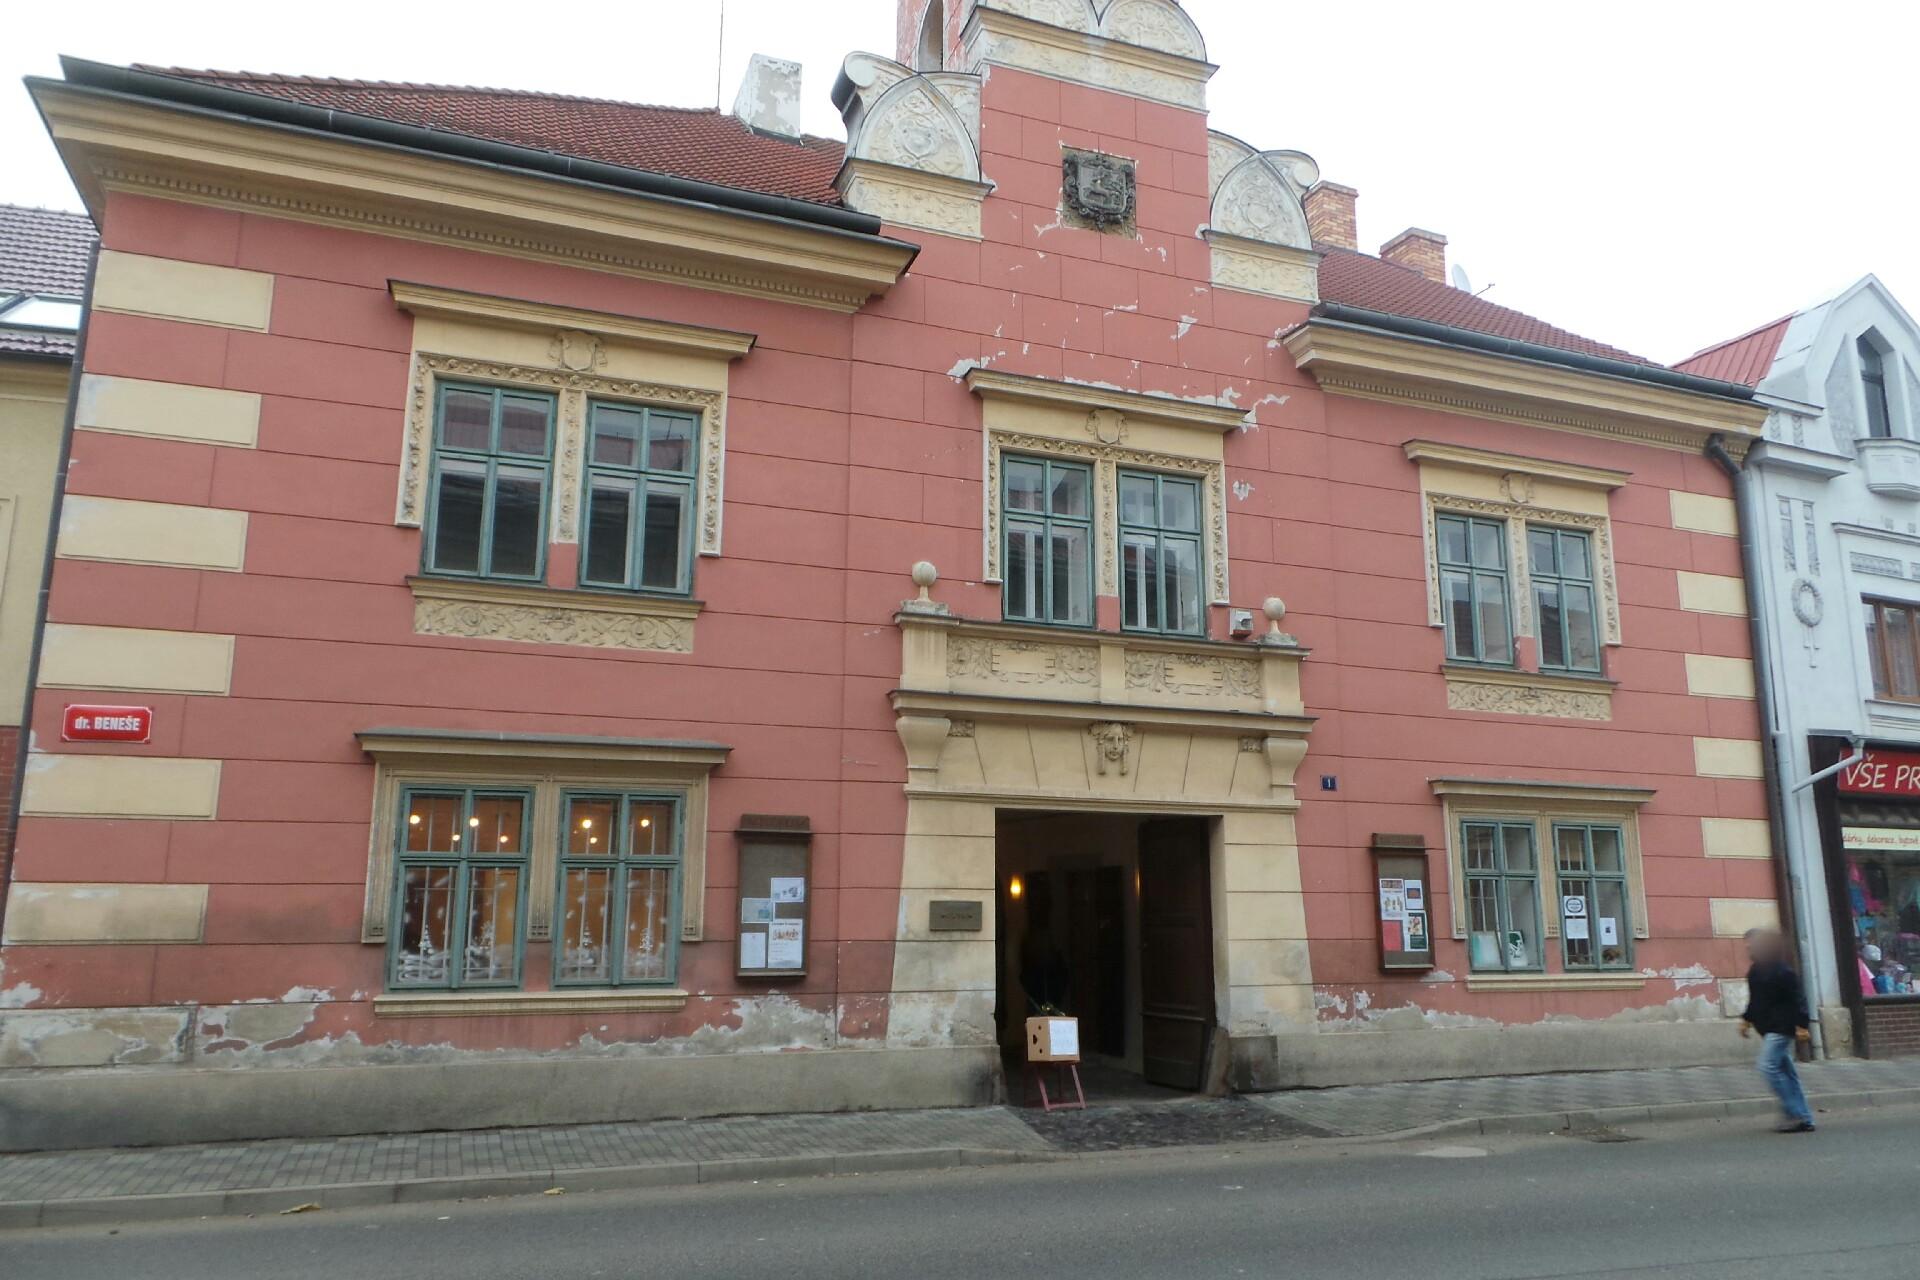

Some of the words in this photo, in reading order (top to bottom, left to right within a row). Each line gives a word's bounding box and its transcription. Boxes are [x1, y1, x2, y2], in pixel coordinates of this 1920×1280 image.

[74, 716, 91, 729] dr.
[94, 715, 141, 731] BENEŠE
[1846, 753, 1889, 788] VŠE
